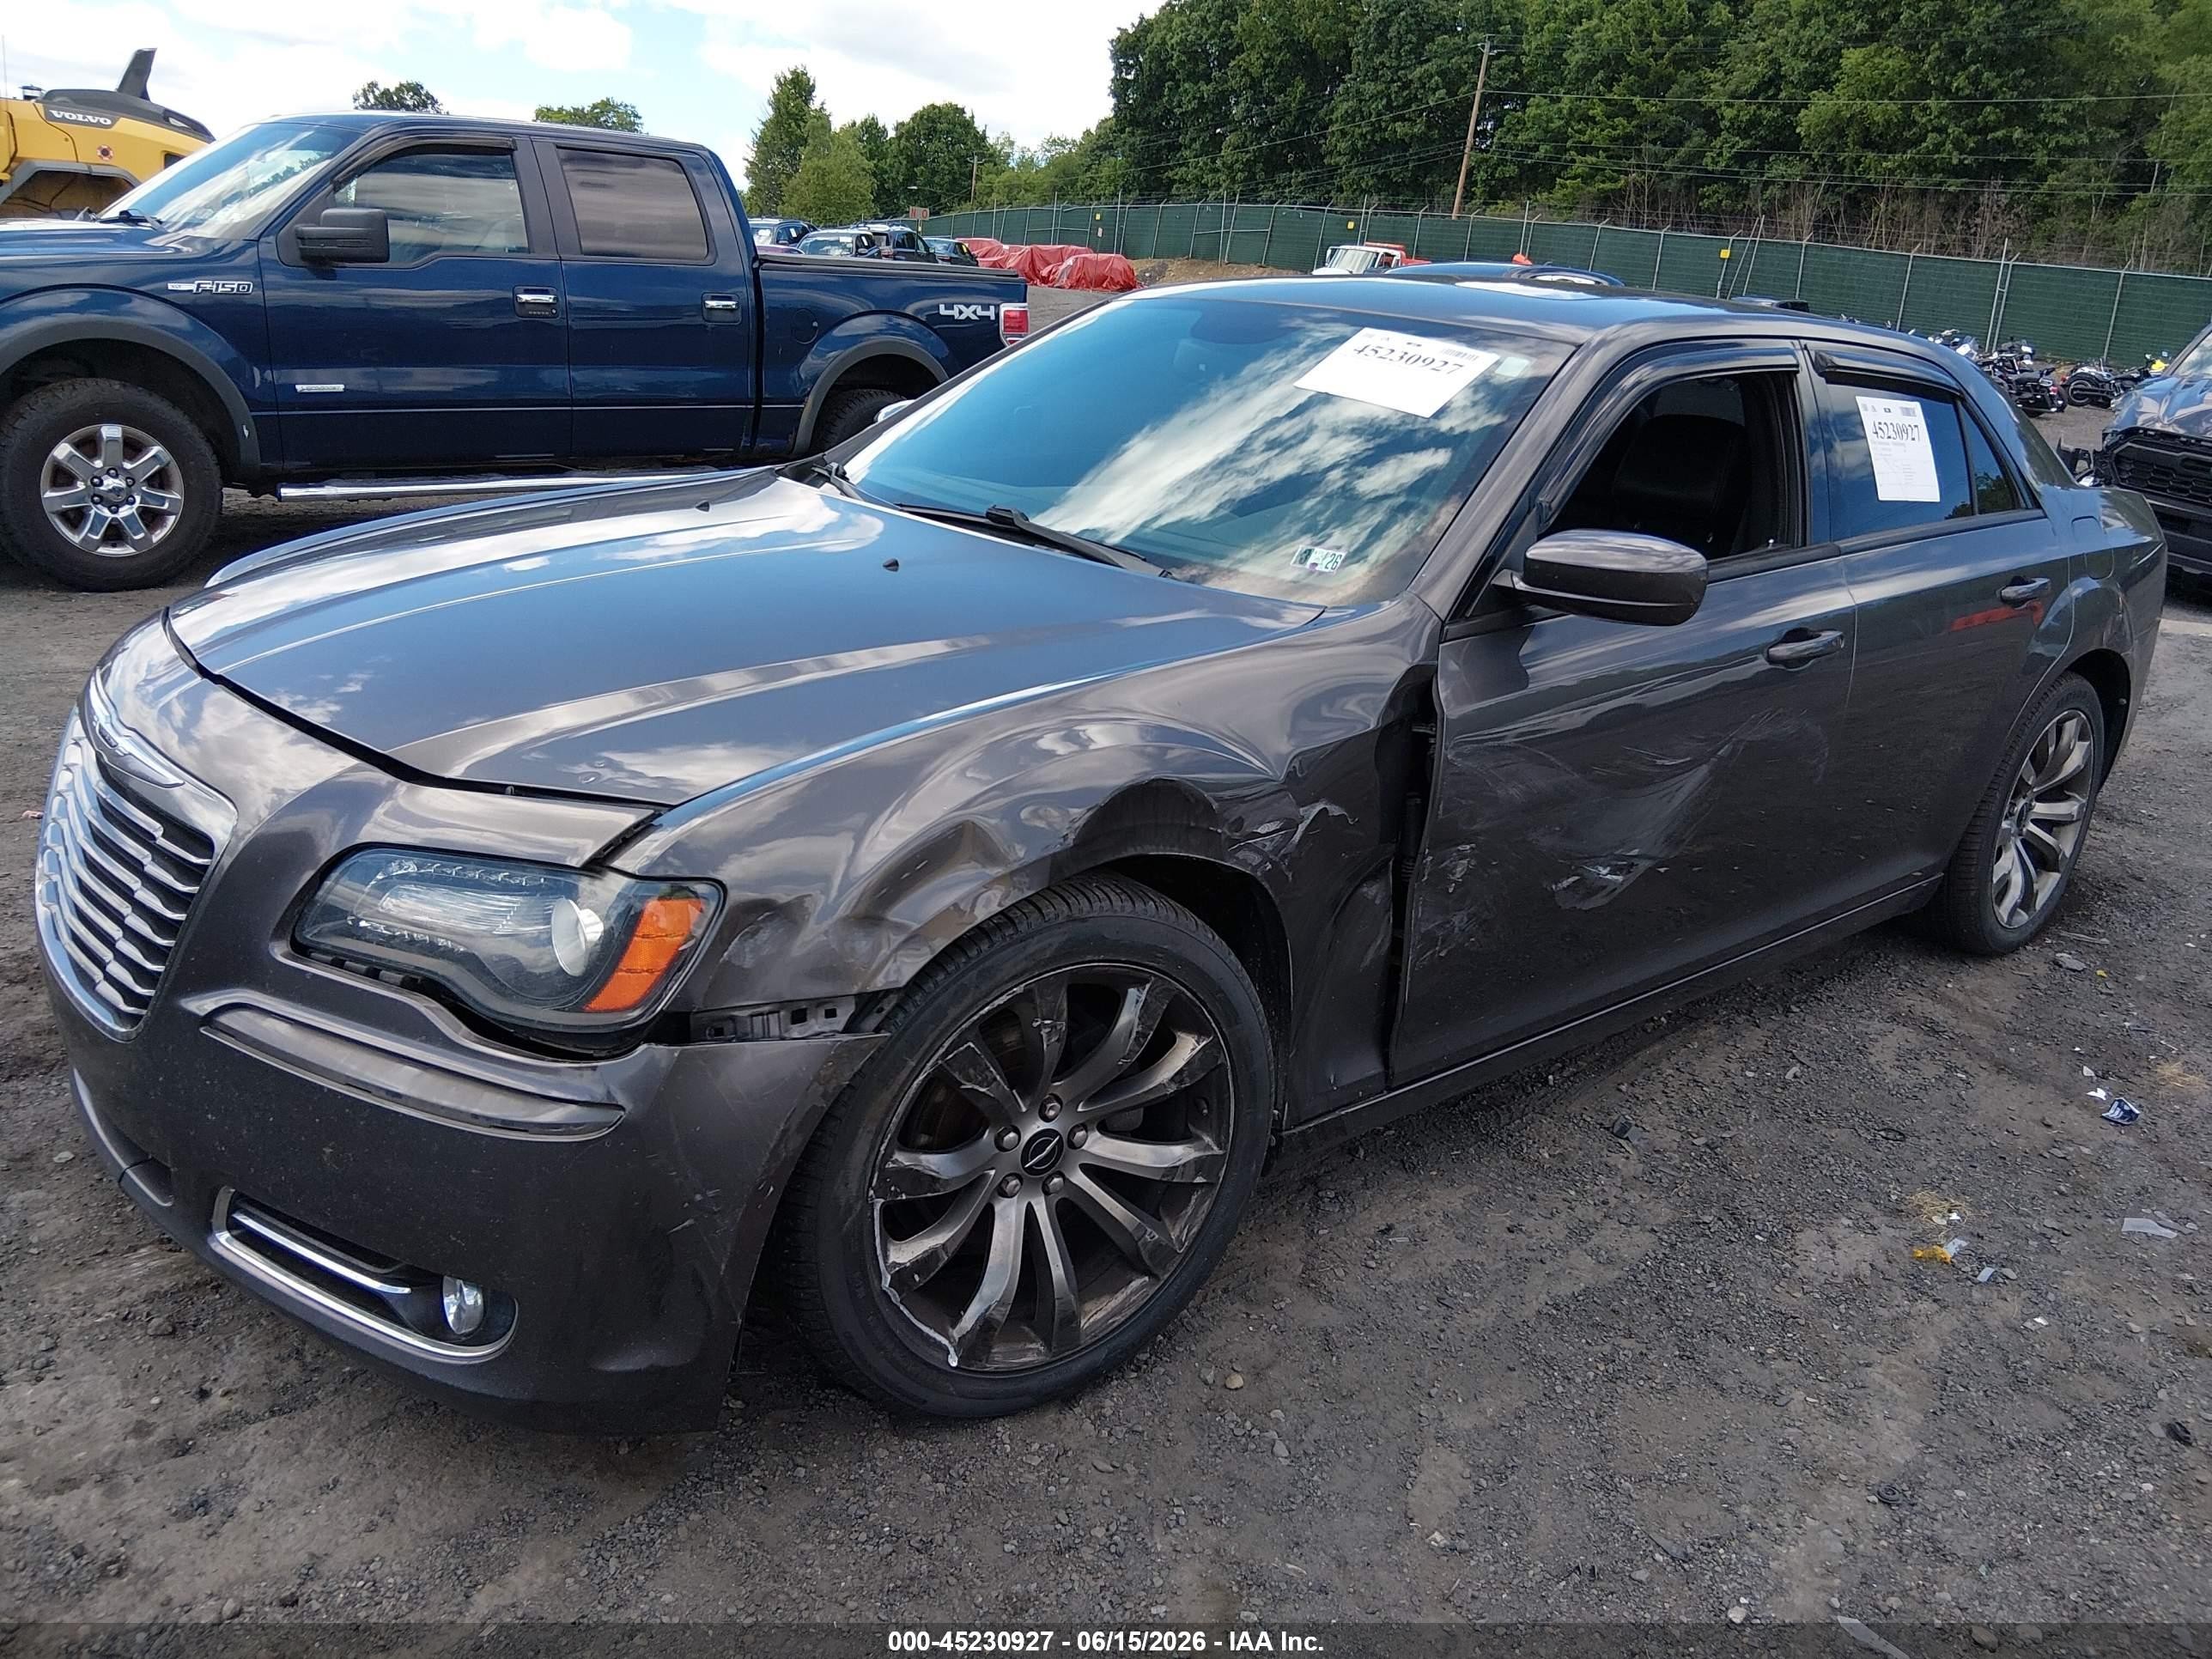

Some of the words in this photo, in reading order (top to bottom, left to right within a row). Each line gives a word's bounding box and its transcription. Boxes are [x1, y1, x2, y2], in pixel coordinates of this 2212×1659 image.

[48, 109, 112, 125] VOLVO
[192, 280, 253, 294] F-150
[939, 303, 995, 320] 4X4
[1352, 343, 1465, 375] 45230927
[1871, 420, 1921, 442] 45230927
